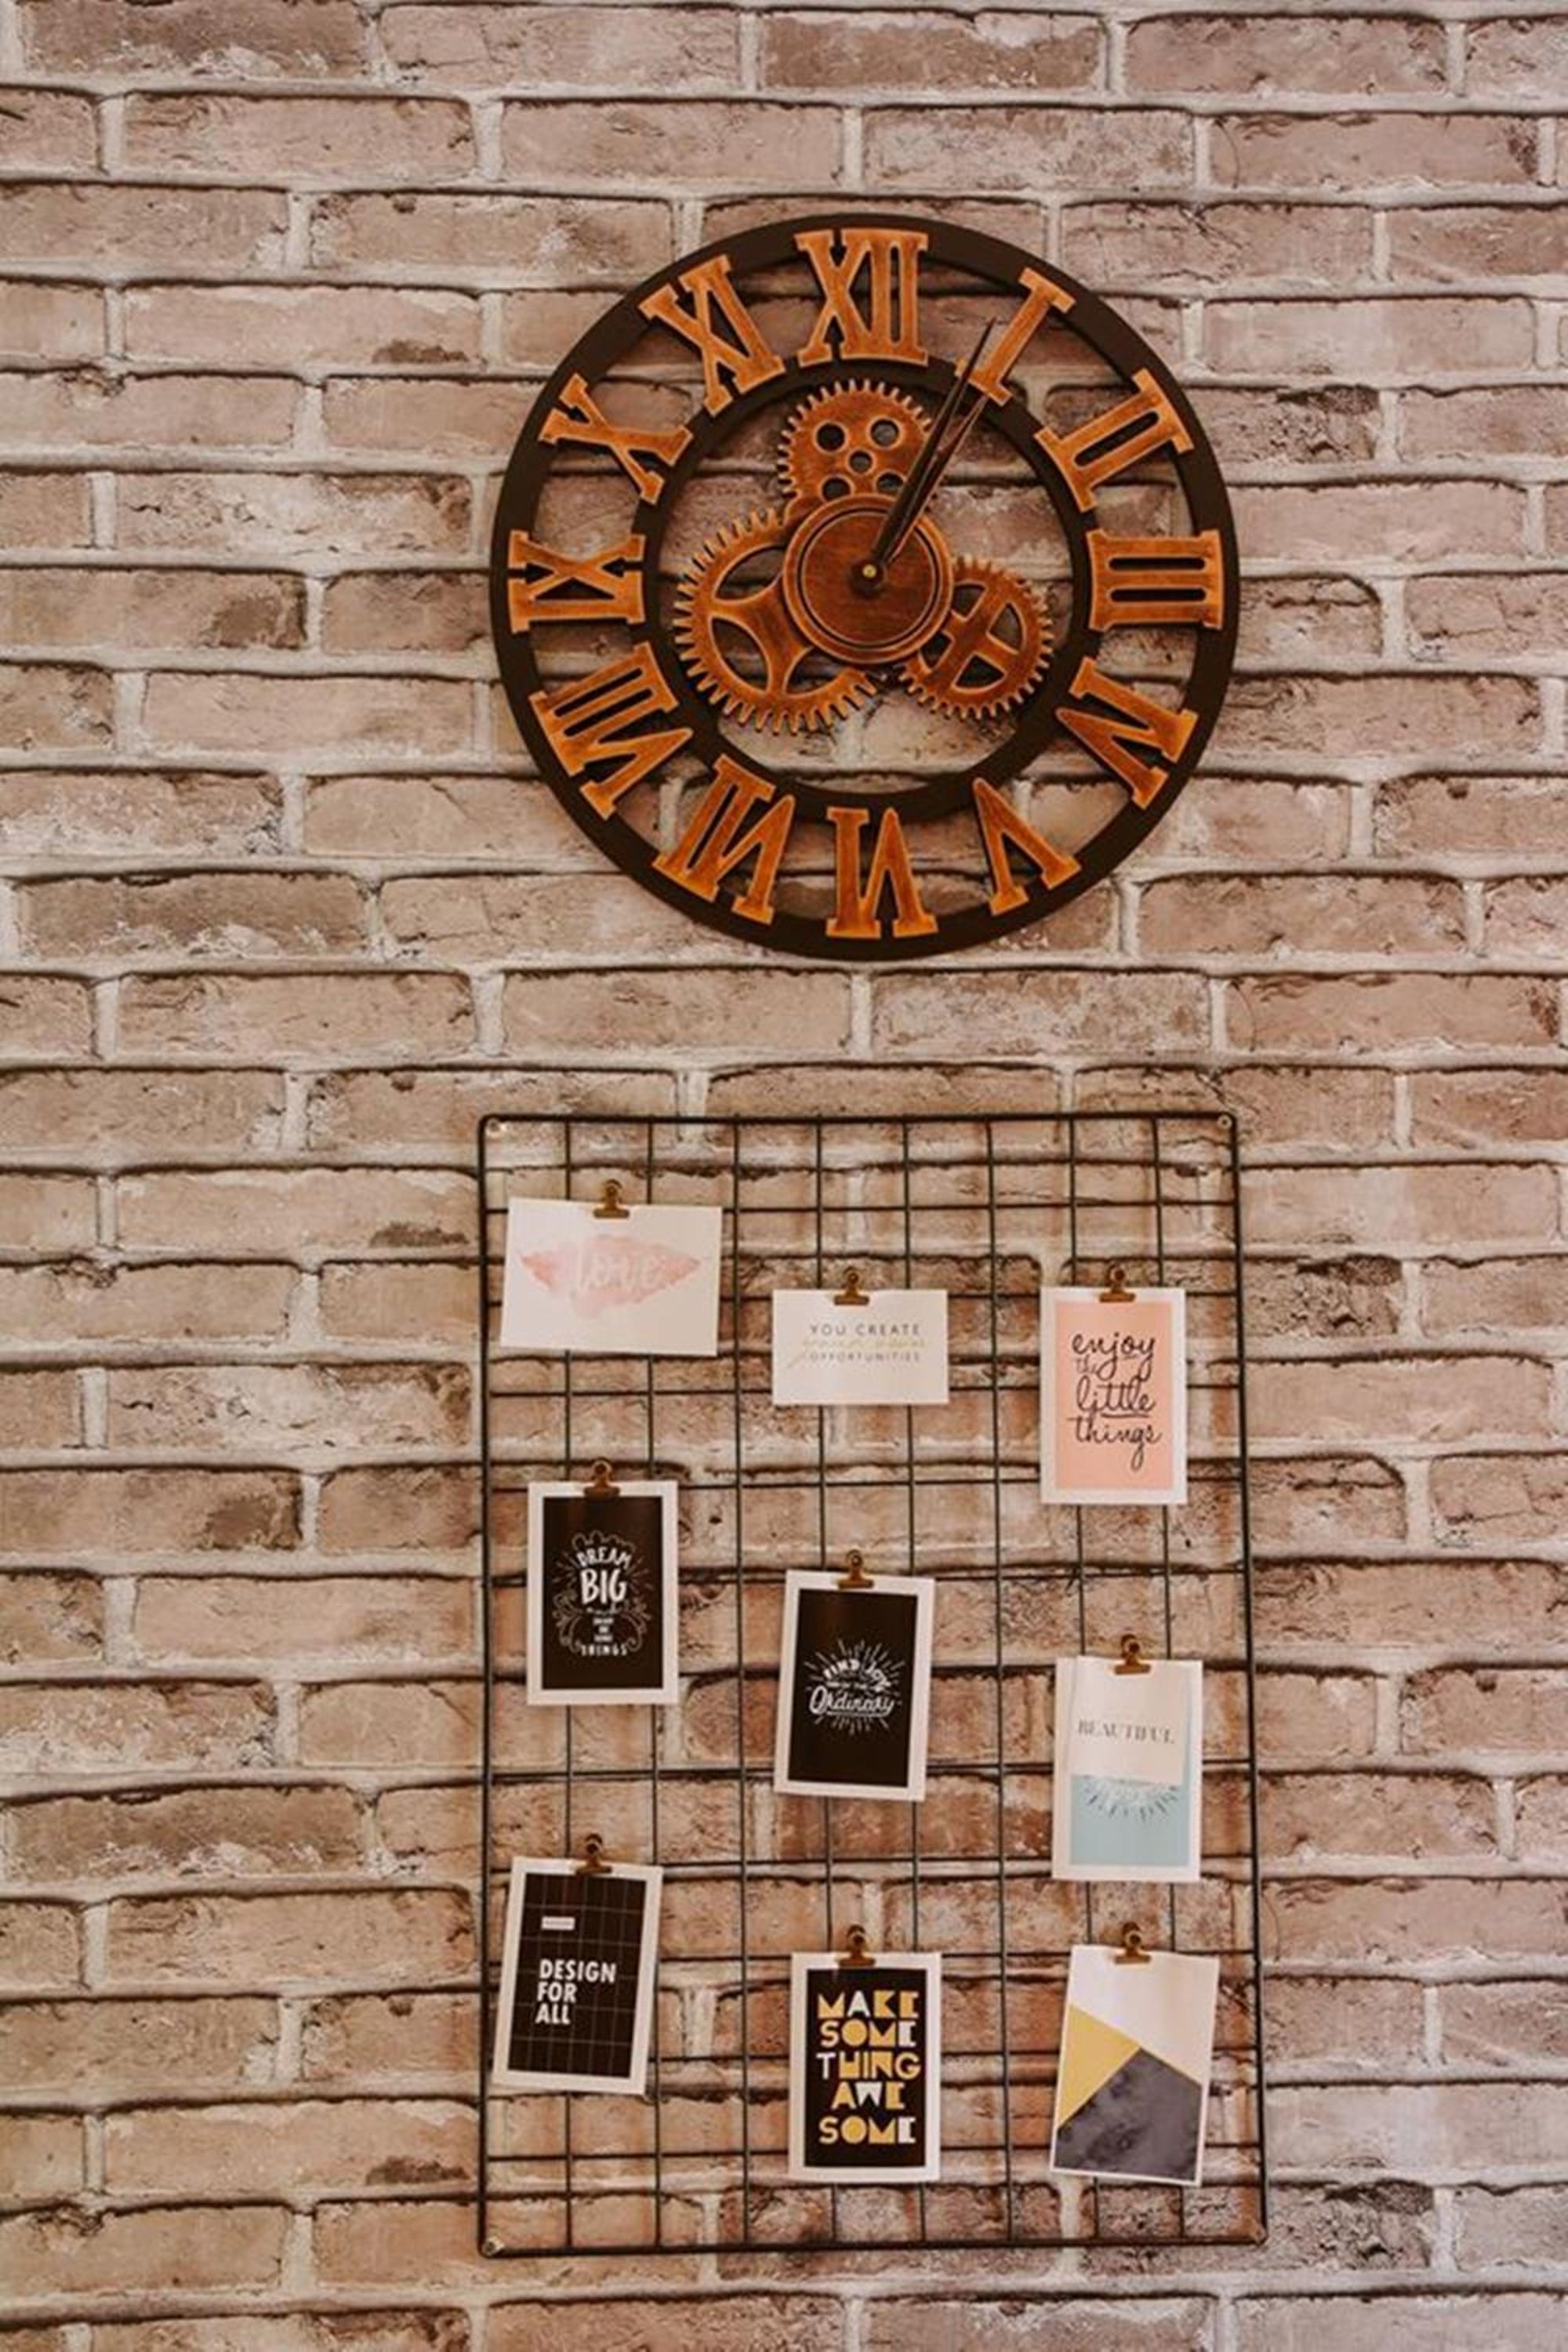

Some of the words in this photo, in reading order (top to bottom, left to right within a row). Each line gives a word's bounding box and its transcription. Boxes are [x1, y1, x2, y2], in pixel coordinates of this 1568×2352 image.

[793, 228, 928, 367] XII
[638, 254, 785, 416] XI
[955, 267, 1076, 407] I
[539, 372, 693, 505] X
[1034, 368, 1194, 514] II
[507, 529, 645, 634] IX
[1085, 528, 1224, 630] III
[528, 641, 693, 821] VIII
[1056, 656, 1199, 809] IV
[652, 753, 795, 925] VII
[972, 777, 1081, 916] V
[826, 807, 938, 938] VI
[809, 1323, 846, 1336] YOU
[855, 1323, 920, 1336] CREATE
[1072, 1332, 1155, 1381] enjoy
[1076, 1374, 1156, 1412] little
[1067, 1414, 1162, 1471] things
[576, 1547, 632, 1570] DREAM
[580, 1569, 626, 1604] BIG
[809, 1686, 895, 1718] Ordinary
[537, 1982, 577, 2003] FOR
[539, 1958, 617, 1984] DESIGN
[535, 2004, 571, 2024] ALL
[818, 1991, 919, 2019] MAKE
[820, 2019, 916, 2048] SOME
[816, 2051, 921, 2080] THING
[831, 2081, 905, 2110] AWE
[818, 2116, 916, 2144] SOME
